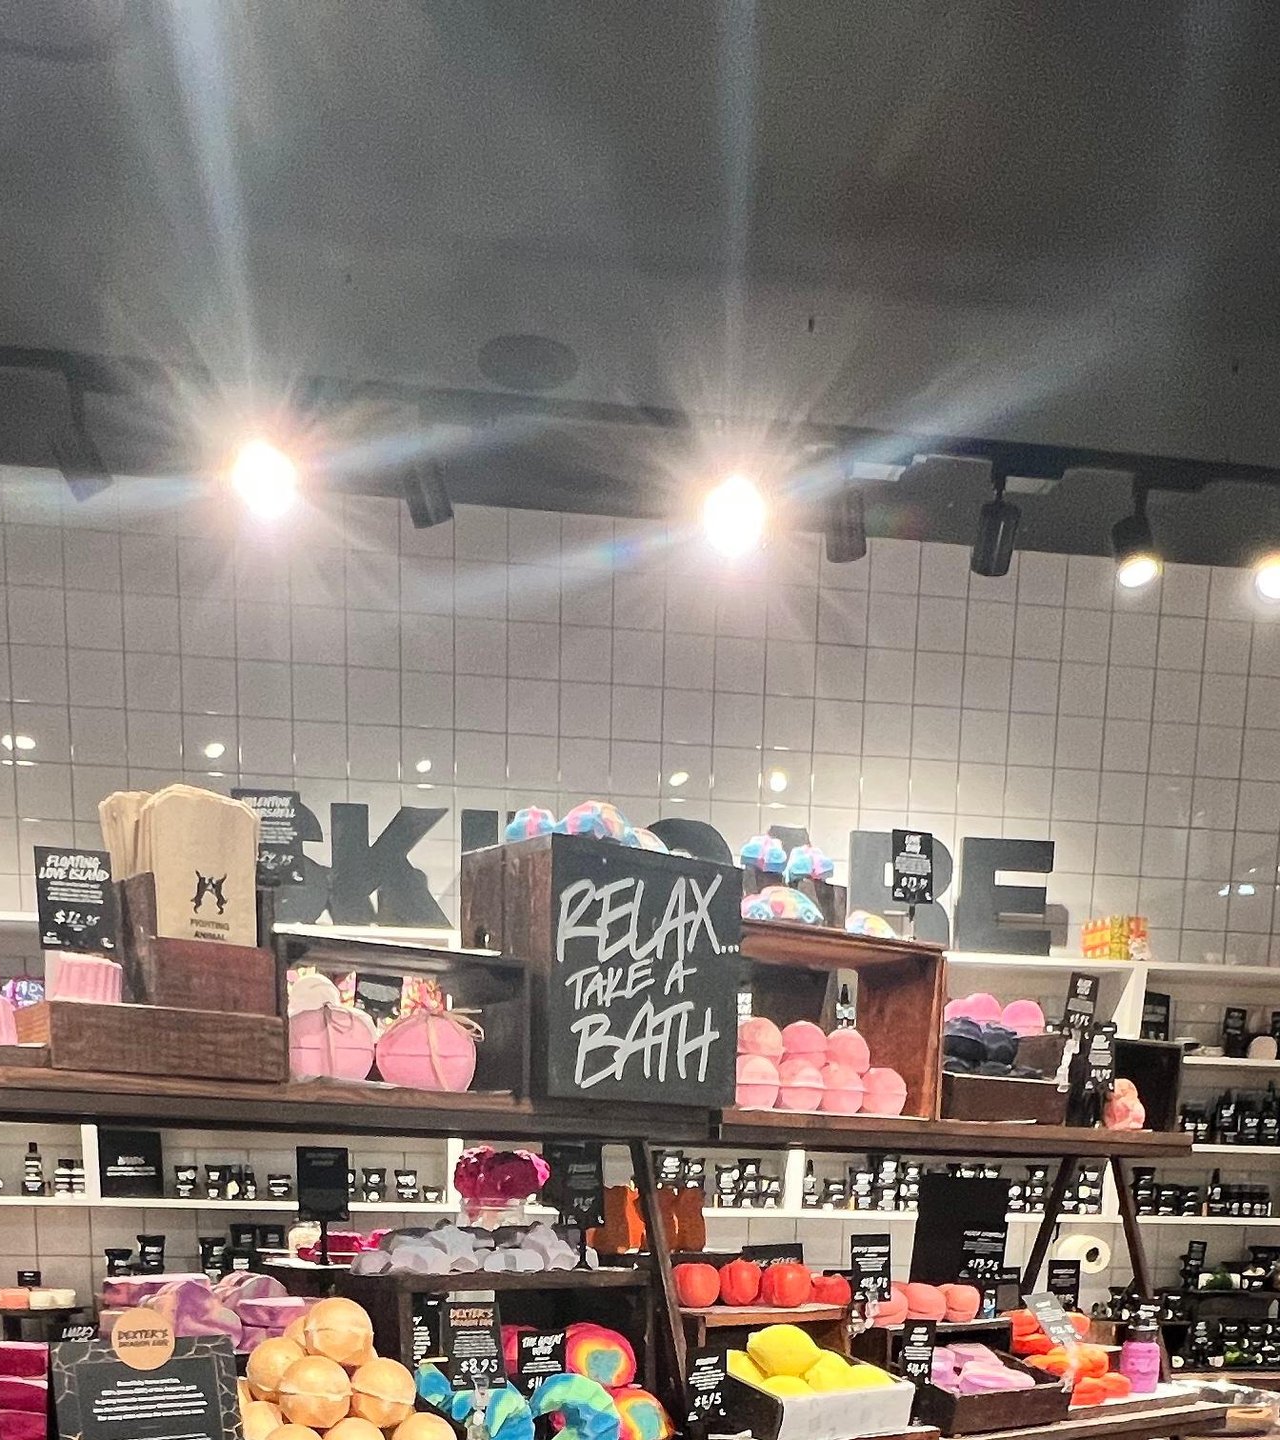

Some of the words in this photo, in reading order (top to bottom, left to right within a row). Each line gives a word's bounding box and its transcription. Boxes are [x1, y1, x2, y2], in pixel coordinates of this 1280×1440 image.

[38, 866, 67, 880] LOVE
[46, 854, 101, 871] FLOATING
[565, 958, 655, 1010] TAKE
[664, 959, 697, 995] A
[570, 995, 720, 1089] BATH
